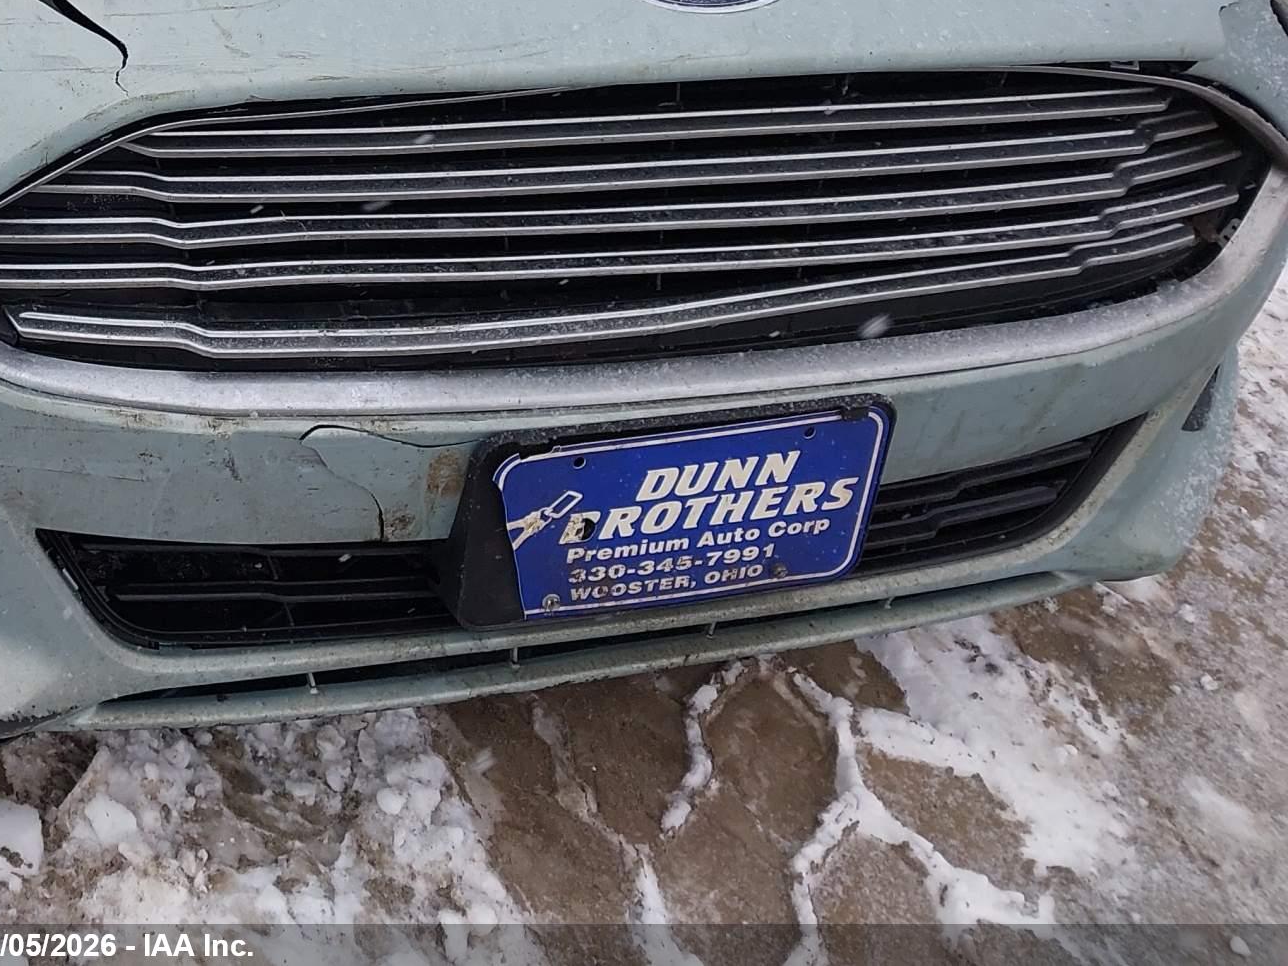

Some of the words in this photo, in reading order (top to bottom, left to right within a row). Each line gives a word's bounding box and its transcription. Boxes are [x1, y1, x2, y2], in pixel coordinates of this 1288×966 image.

[635, 450, 801, 502] DUNN
[558, 477, 860, 545] BROTHERS
[566, 537, 690, 564] Premium
[697, 528, 762, 549] Auto
[767, 517, 831, 539] Corp
[567, 543, 776, 584] 330-345-7991
[569, 574, 697, 602] WOOSTER,
[703, 564, 765, 585] OHIO
